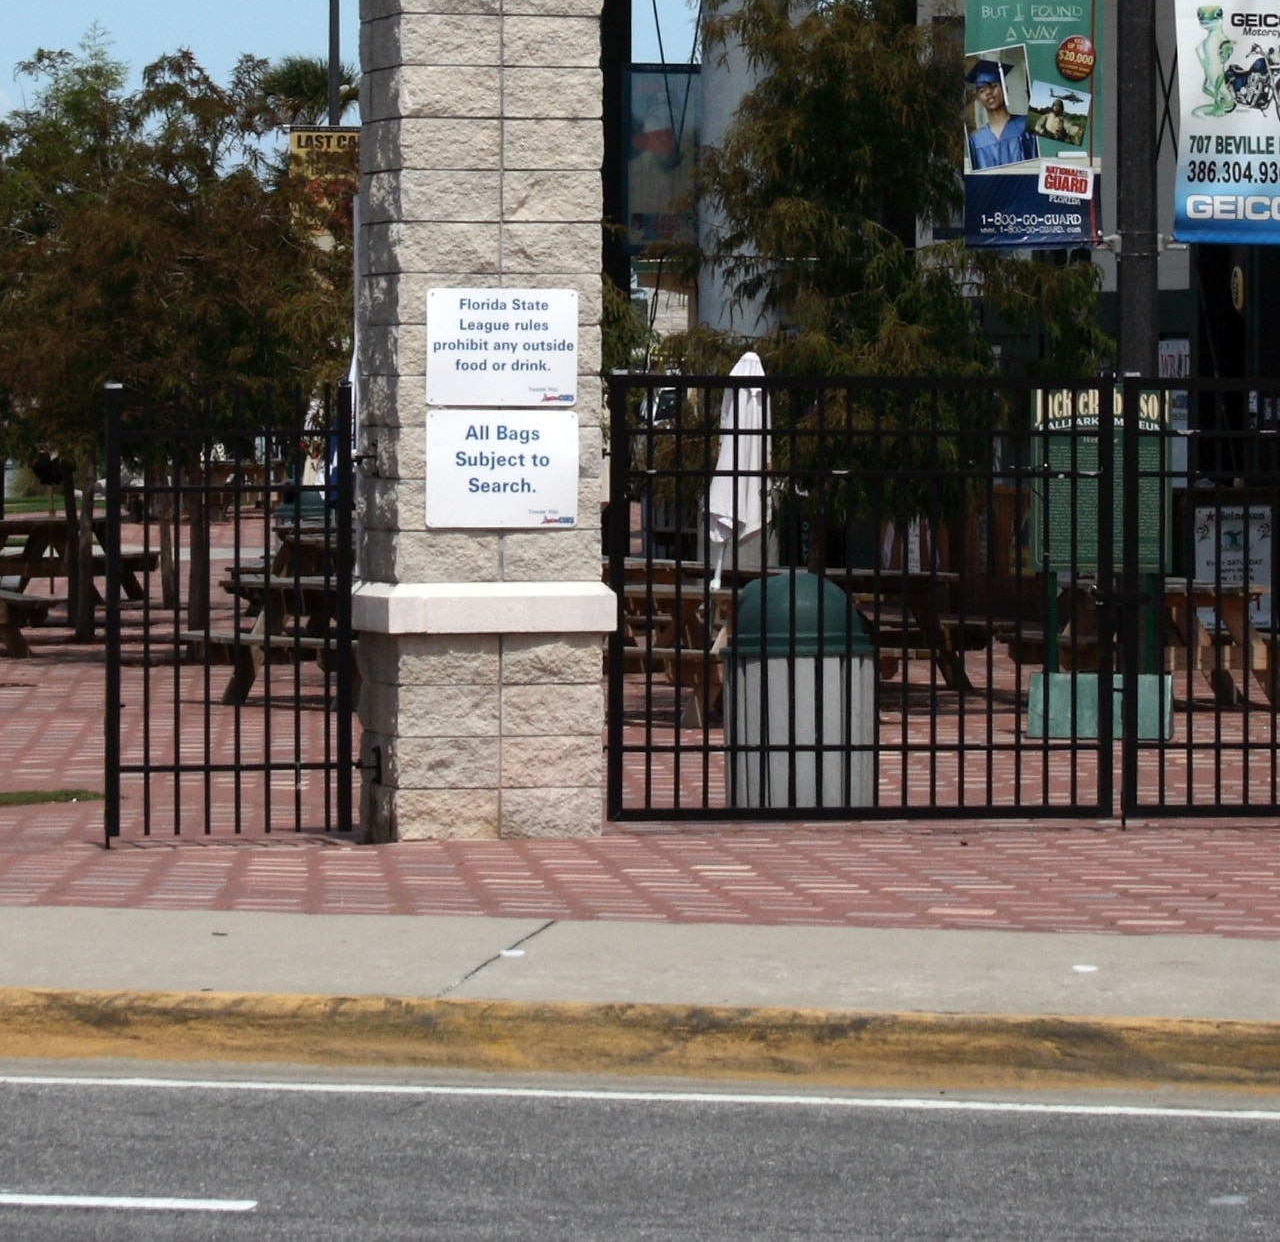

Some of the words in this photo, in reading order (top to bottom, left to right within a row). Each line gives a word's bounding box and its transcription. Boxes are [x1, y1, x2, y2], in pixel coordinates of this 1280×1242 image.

[981, 5, 1010, 19] BUT
[1031, 4, 1083, 17] FOUND
[1006, 26, 1017, 39] A
[297, 134, 333, 149] LAST
[337, 134, 360, 149] CA
[1189, 135, 1212, 154] 707
[1215, 136, 1275, 155] BEVILLE
[1045, 165, 1078, 177] NATIONAL
[1044, 174, 1088, 194] GUARD
[980, 212, 1082, 225] 1-800-GO-GUARD
[459, 298, 507, 311] Florida
[512, 298, 549, 311] State
[459, 318, 510, 333] League
[514, 319, 549, 331] rules
[433, 338, 489, 353] prohibit
[493, 341, 518, 353] any
[523, 339, 574, 351] outside
[455, 359, 487, 371] food
[492, 362, 507, 371] or
[511, 359, 551, 371] drink.
[465, 424, 489, 440] All
[496, 425, 541, 444] Bags
[455, 451, 525, 470] Subject
[531, 453, 550, 467] to
[468, 477, 537, 493] Search.
